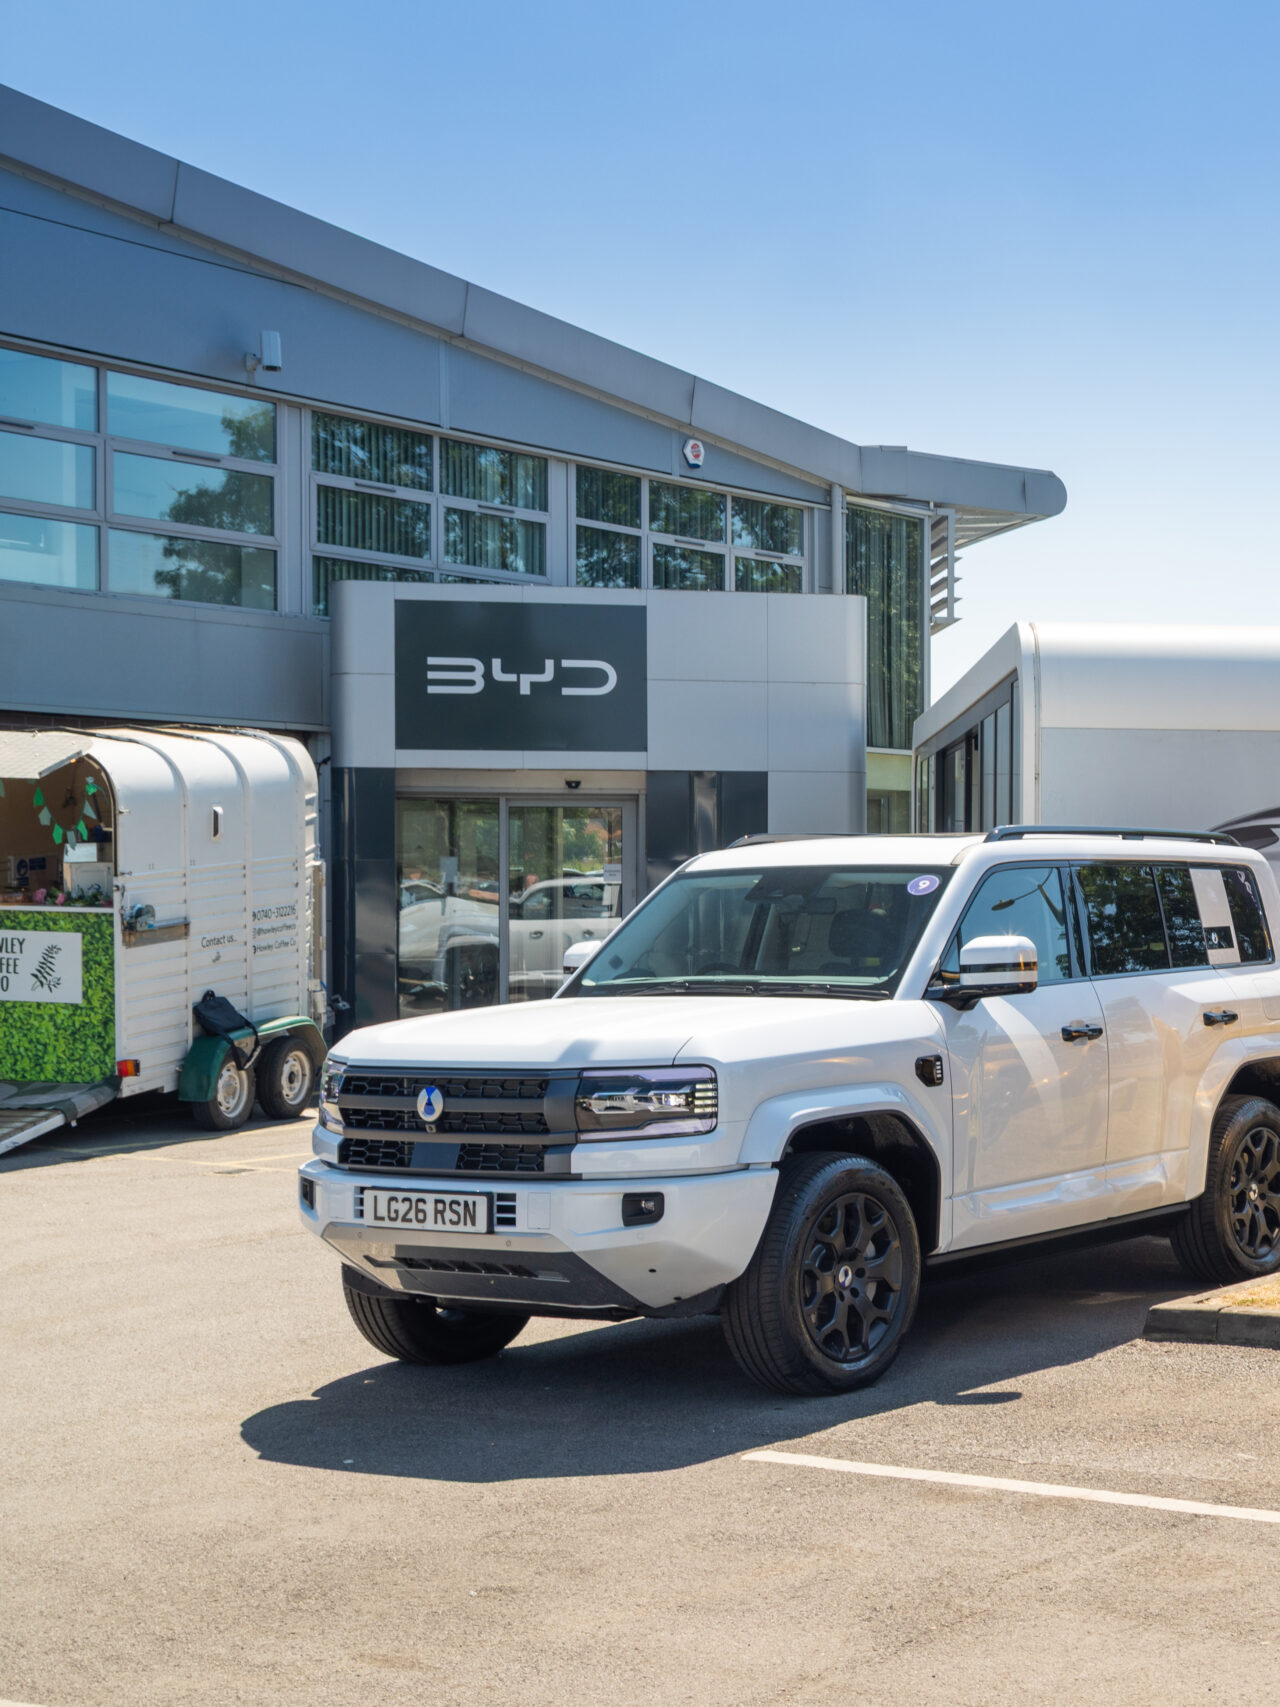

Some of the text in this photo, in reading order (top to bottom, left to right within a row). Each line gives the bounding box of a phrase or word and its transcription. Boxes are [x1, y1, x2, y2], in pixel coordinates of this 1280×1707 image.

[427, 656, 617, 696] BYD
[918, 880, 930, 890] 9
[201, 935, 226, 949] Contact
[373, 1194, 477, 1227] LG26 RSN
